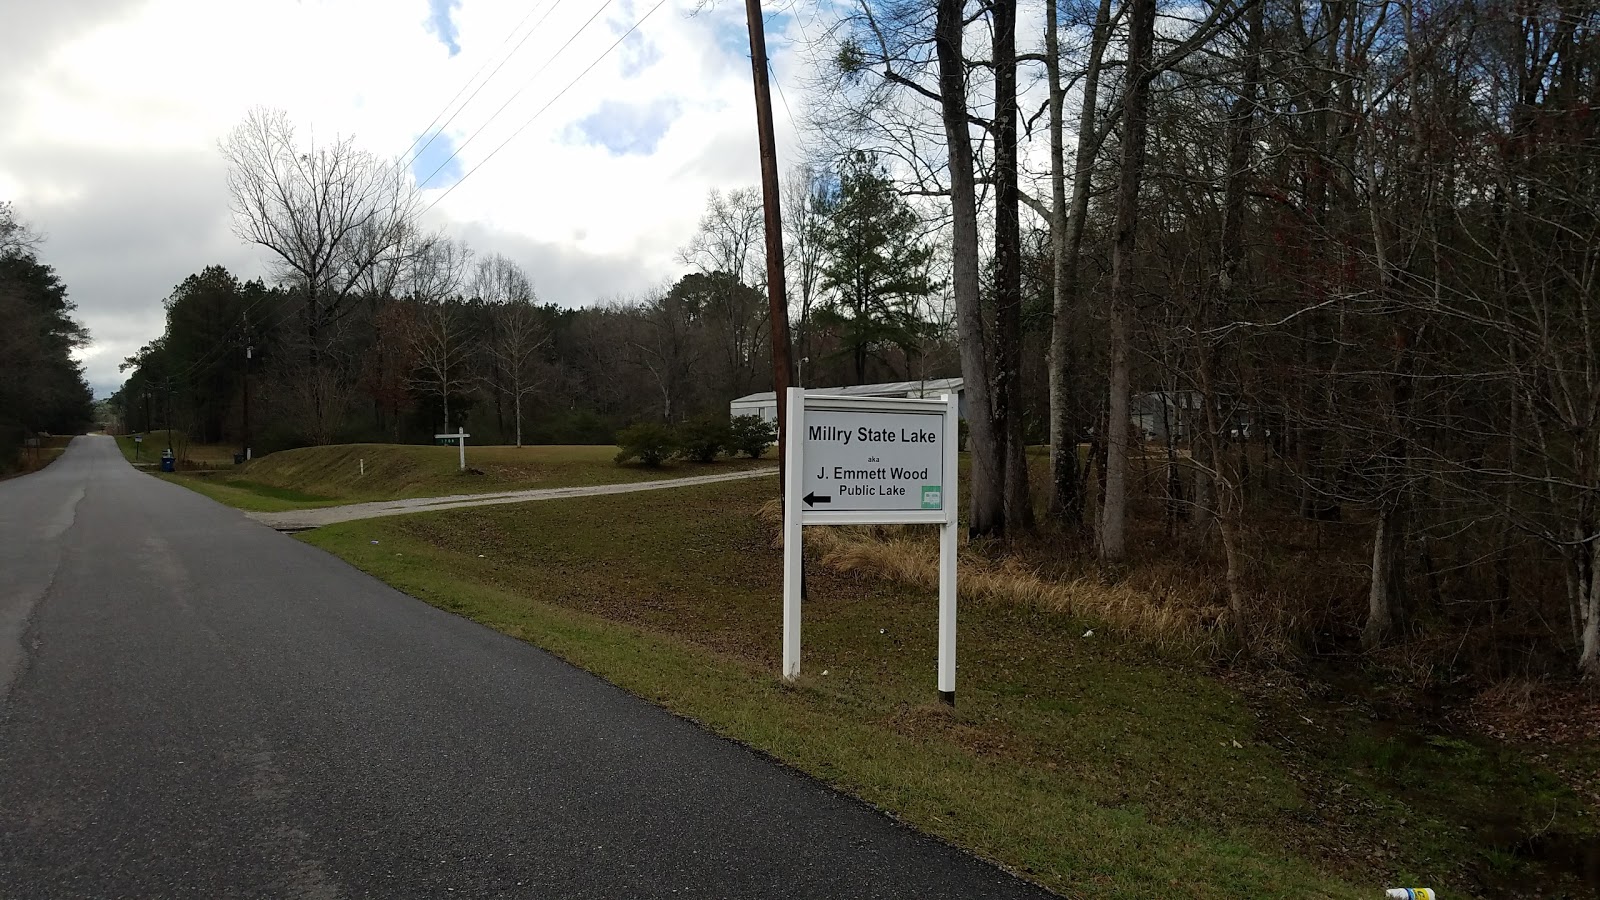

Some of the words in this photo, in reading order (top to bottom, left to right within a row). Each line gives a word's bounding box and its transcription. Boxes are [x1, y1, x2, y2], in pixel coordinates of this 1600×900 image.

[809, 426, 852, 445] Millry
[858, 427, 895, 442] State
[902, 429, 936, 443] Lake
[817, 467, 829, 480] J.
[834, 467, 886, 480] Emmett
[890, 468, 928, 480] Wood
[839, 485, 876, 496] Public
[879, 485, 906, 496] Lake
